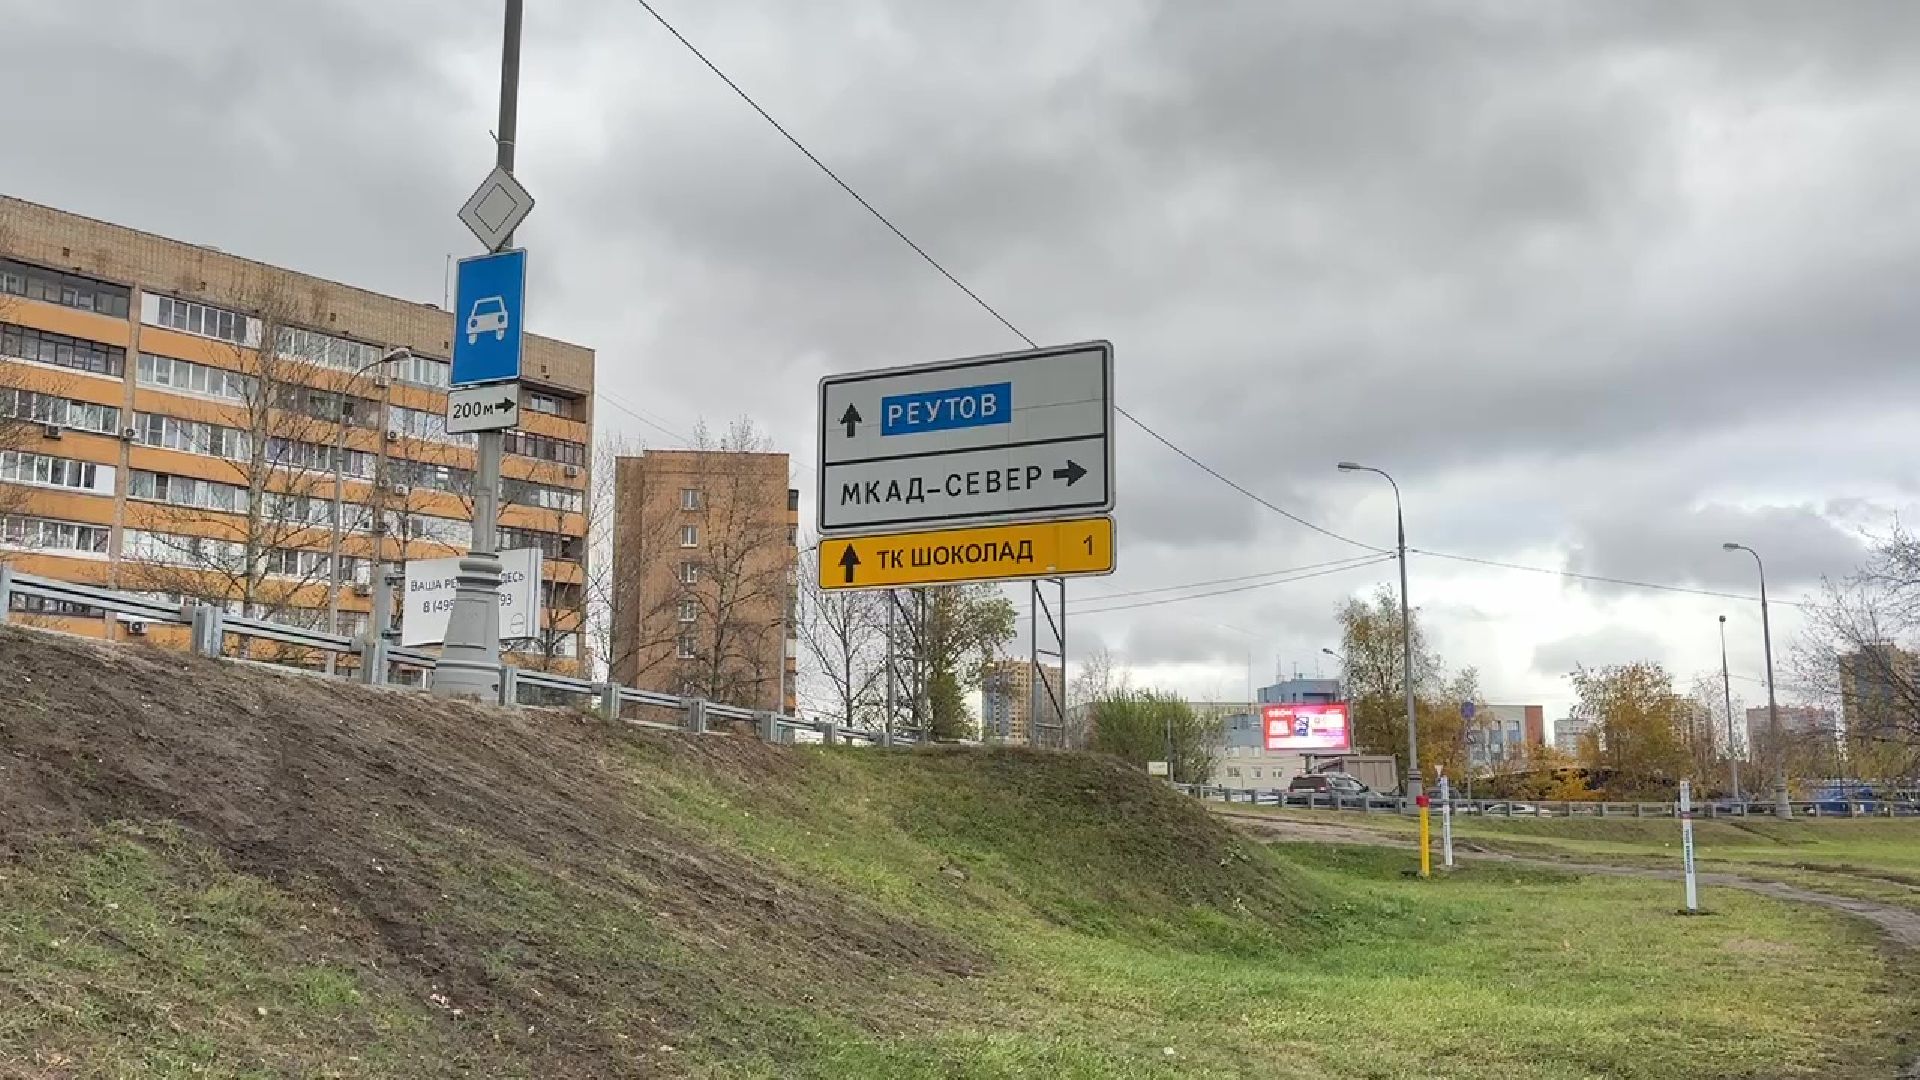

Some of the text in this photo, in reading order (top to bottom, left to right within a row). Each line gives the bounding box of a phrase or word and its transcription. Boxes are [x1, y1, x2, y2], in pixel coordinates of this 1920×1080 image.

[888, 393, 997, 427] РЕУТОВ
[840, 466, 1042, 506] МКАД-СЕВЕР
[877, 535, 1093, 570] ТК ШОКОЛАД 1
[410, 579, 442, 592] ВАША
[500, 571, 526, 584] ДЕСЬ
[500, 593, 512, 607] 93
